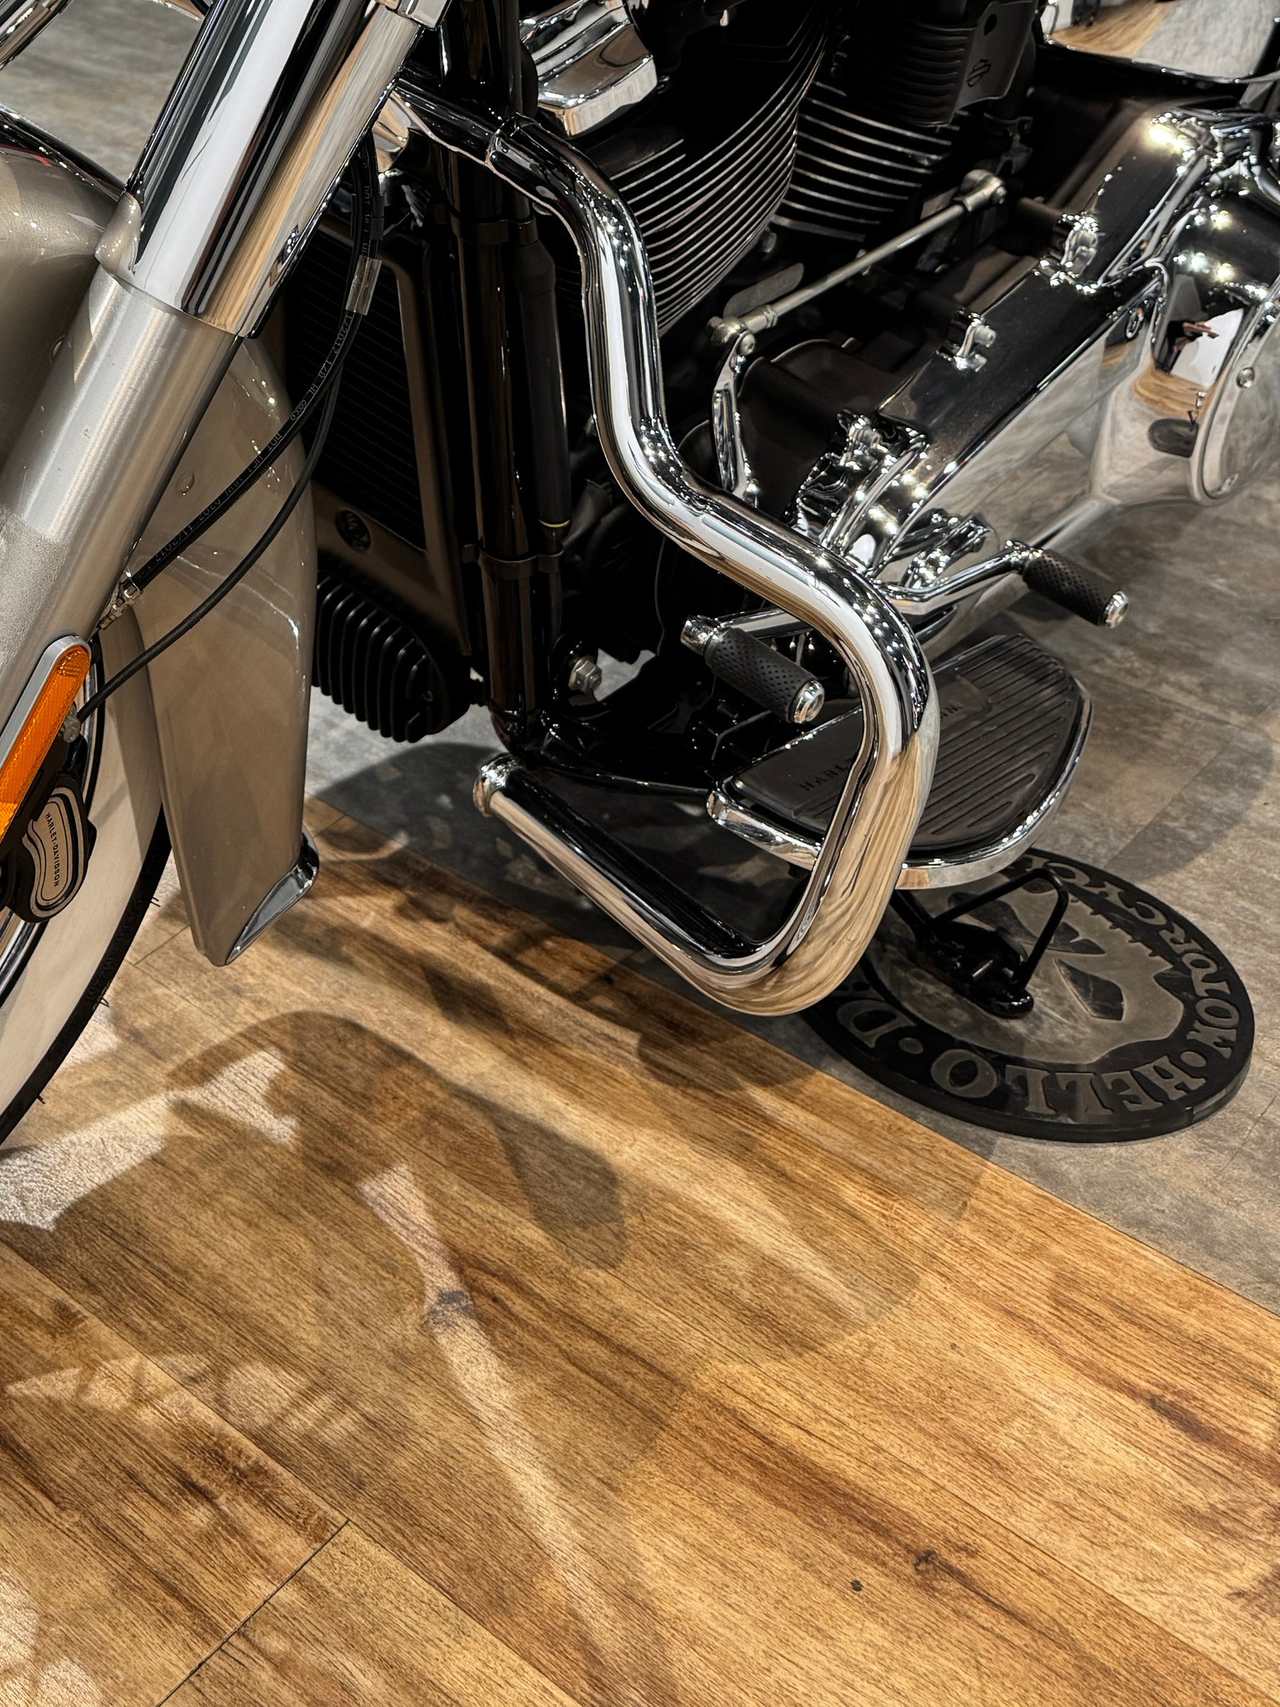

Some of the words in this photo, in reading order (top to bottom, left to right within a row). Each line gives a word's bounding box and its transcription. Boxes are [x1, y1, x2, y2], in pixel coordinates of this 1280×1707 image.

[45, 812, 61, 888] HARLEY-DAVIDSON
[1025, 855, 1240, 1059] MOTORCYC
[930, 1049, 1207, 1116] HELLO
